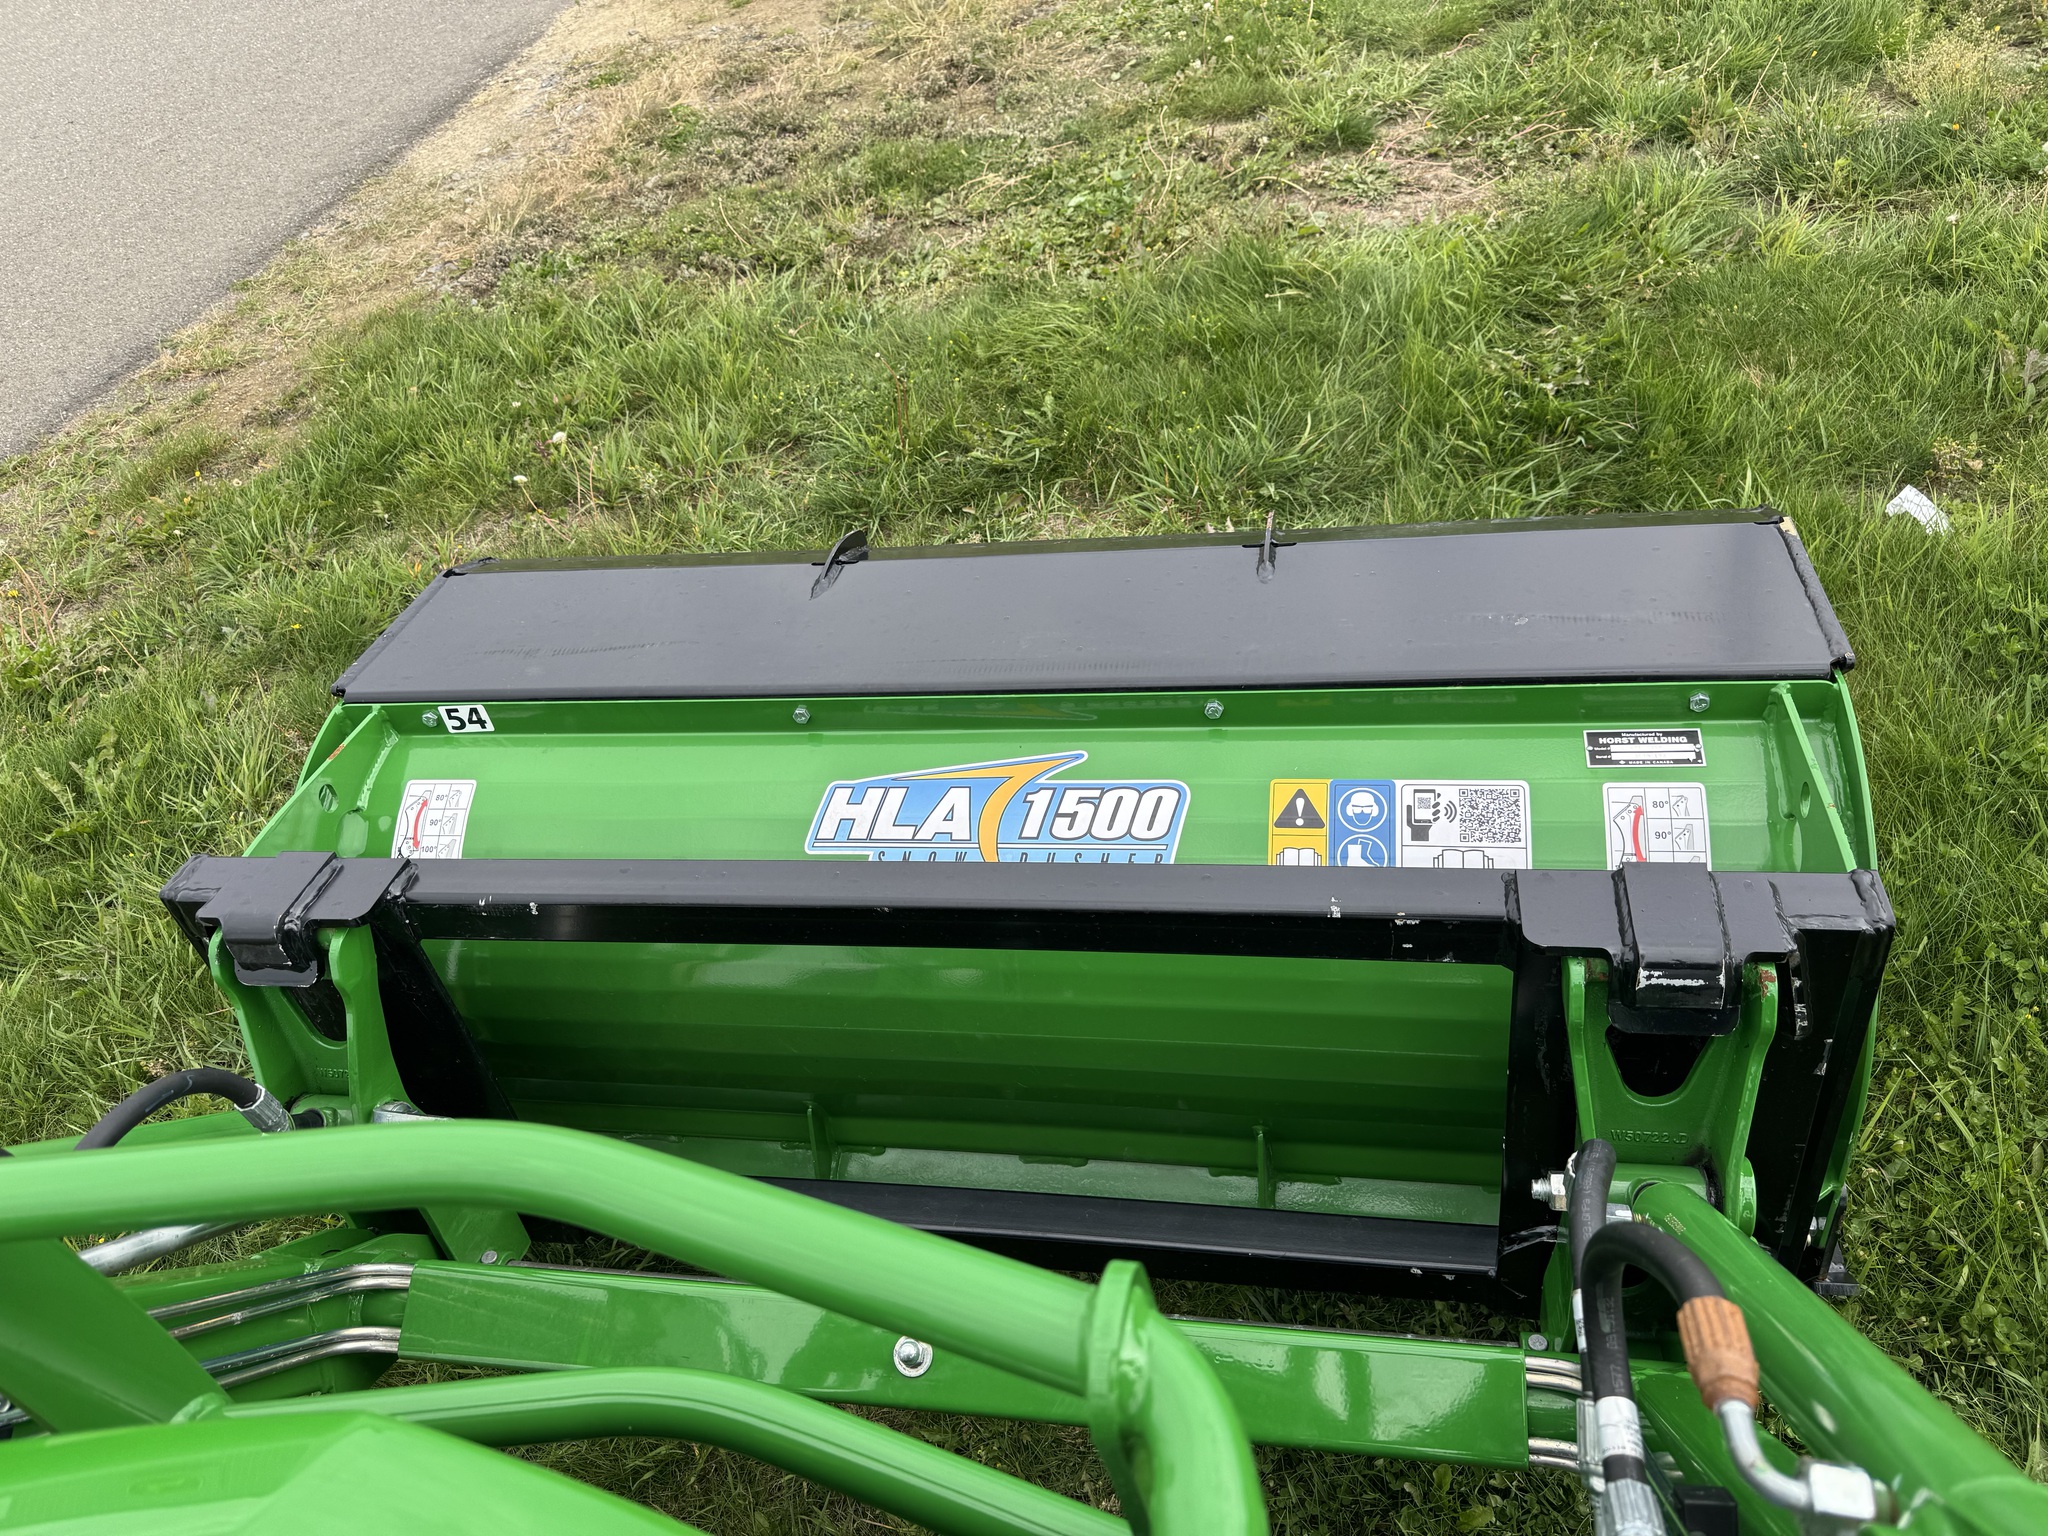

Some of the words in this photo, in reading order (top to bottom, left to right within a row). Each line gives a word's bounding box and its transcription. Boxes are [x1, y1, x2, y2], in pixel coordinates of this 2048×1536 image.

[444, 707, 488, 731] 54
[1638, 736, 1688, 744] WELDING
[1652, 800, 1669, 809] 80°
[815, 786, 972, 842] HLA
[1018, 785, 1182, 842] 1500
[429, 818, 442, 826] 90°
[1655, 831, 1672, 840] 90°
[421, 845, 438, 853] 100°
